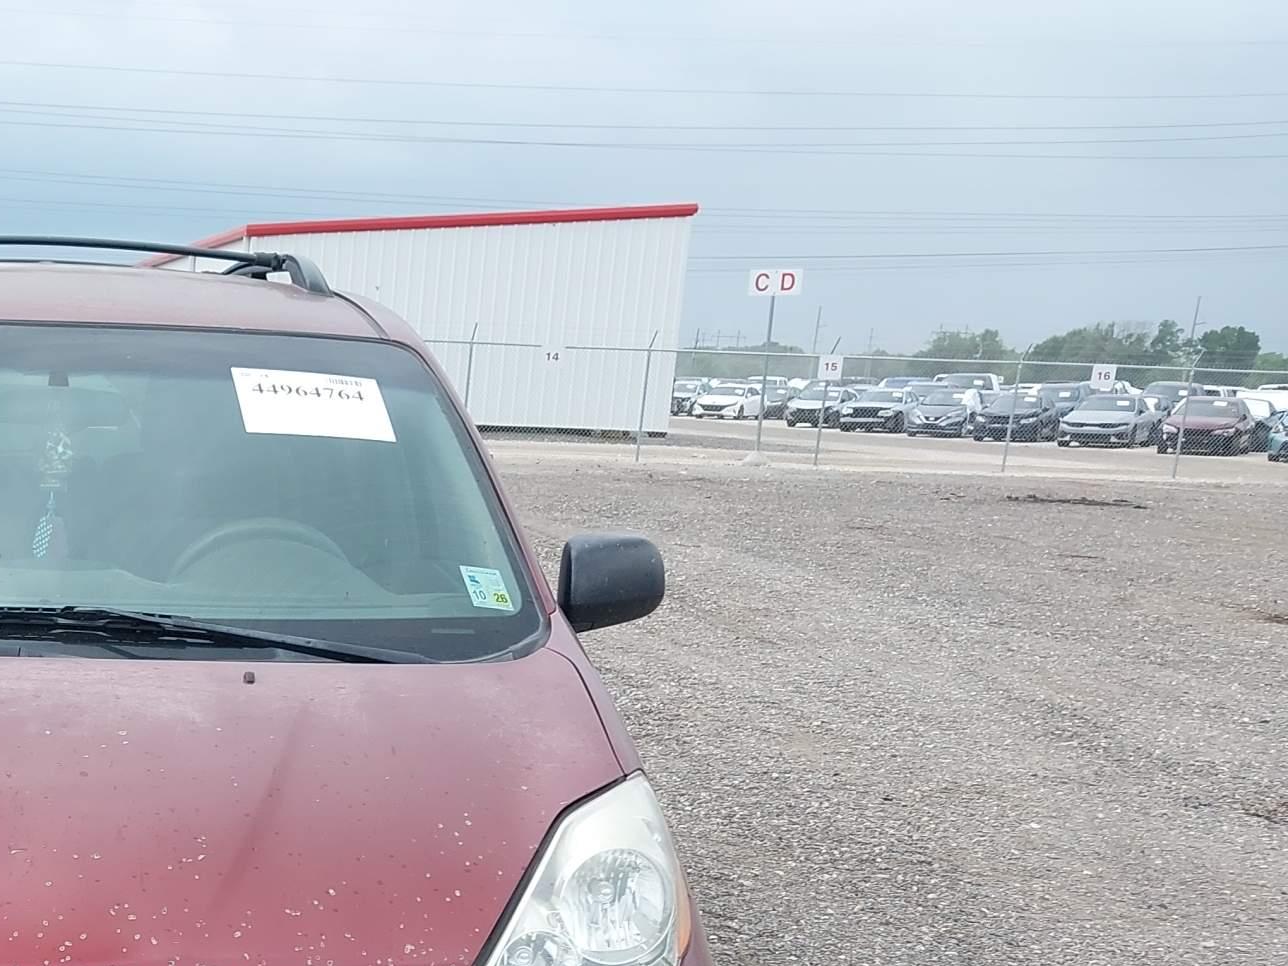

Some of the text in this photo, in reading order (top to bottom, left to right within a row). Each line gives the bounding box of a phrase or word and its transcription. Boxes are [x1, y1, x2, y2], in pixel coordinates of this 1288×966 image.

[755, 272, 796, 292] C D
[546, 352, 560, 361] 14
[824, 362, 838, 371] 15
[1097, 371, 1111, 381] 16
[252, 383, 364, 401] 44964764
[472, 590, 487, 601] 10
